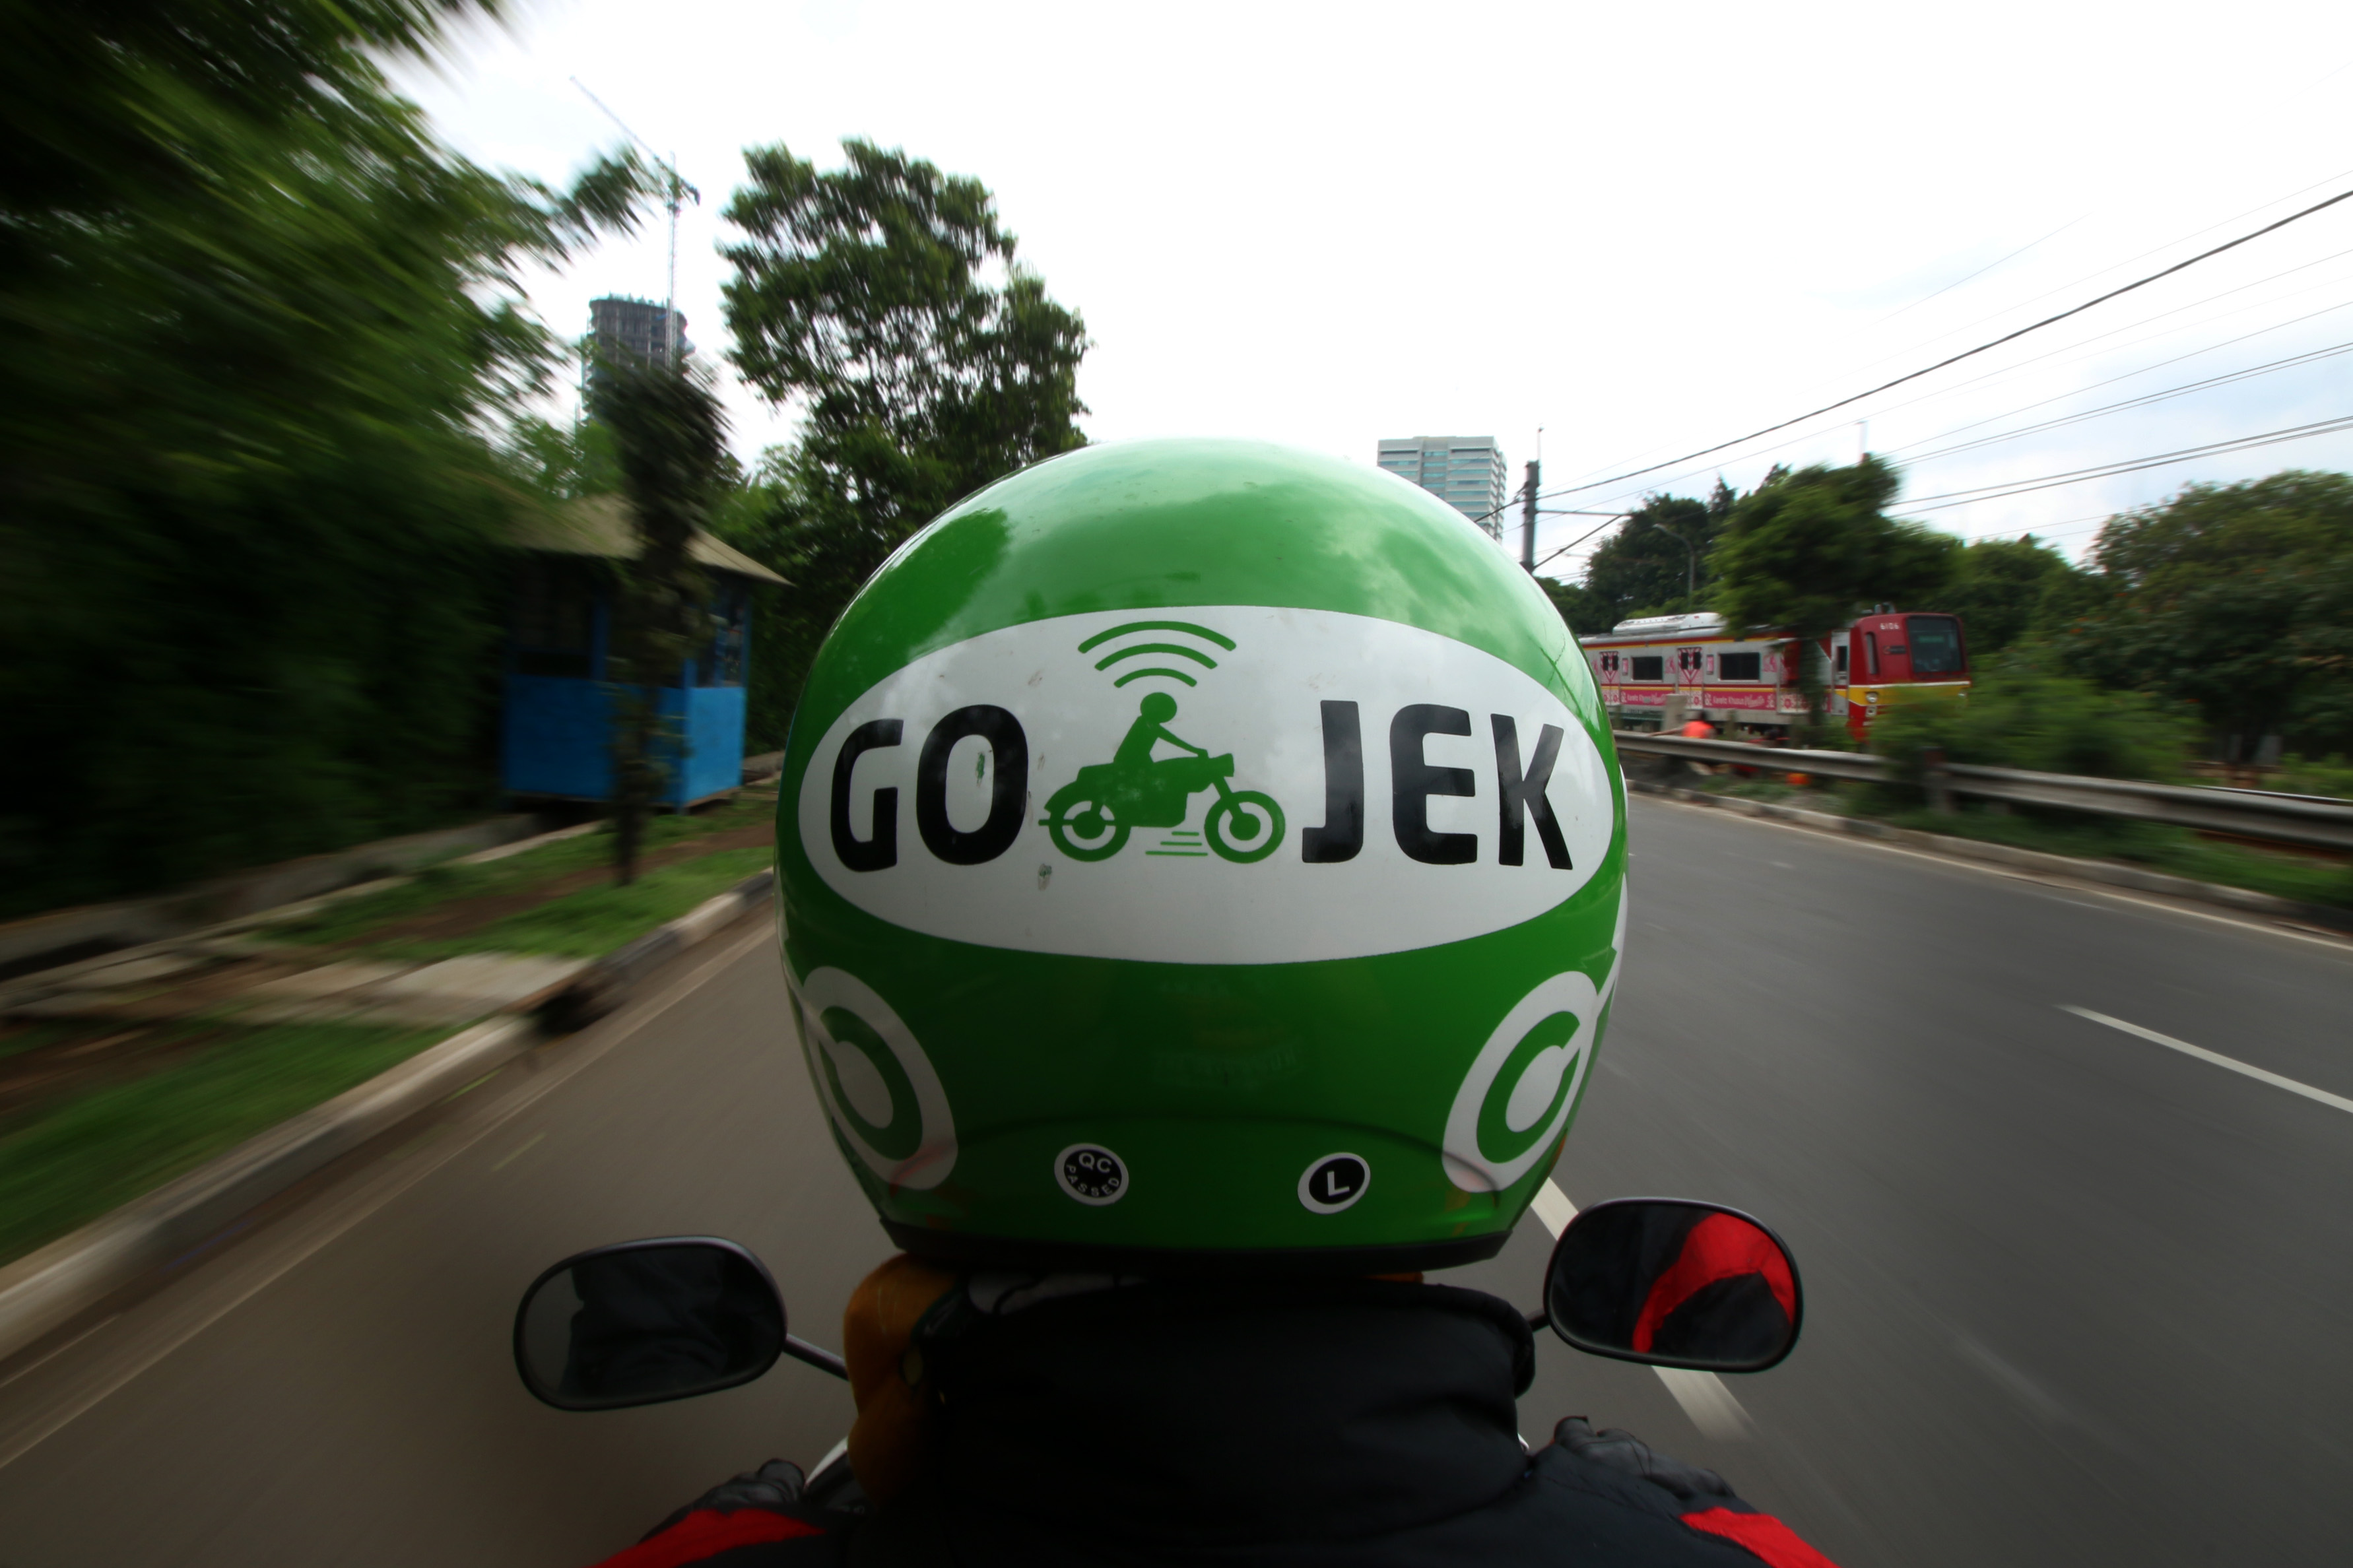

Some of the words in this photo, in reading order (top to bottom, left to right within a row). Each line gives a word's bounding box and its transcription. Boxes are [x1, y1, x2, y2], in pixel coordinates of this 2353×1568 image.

[830, 703, 1029, 872] GO
[1302, 700, 1573, 870] JEK
[1078, 1152, 1111, 1174] QC
[1066, 1164, 1120, 1197] PASSED
[1327, 1171, 1350, 1196] L
